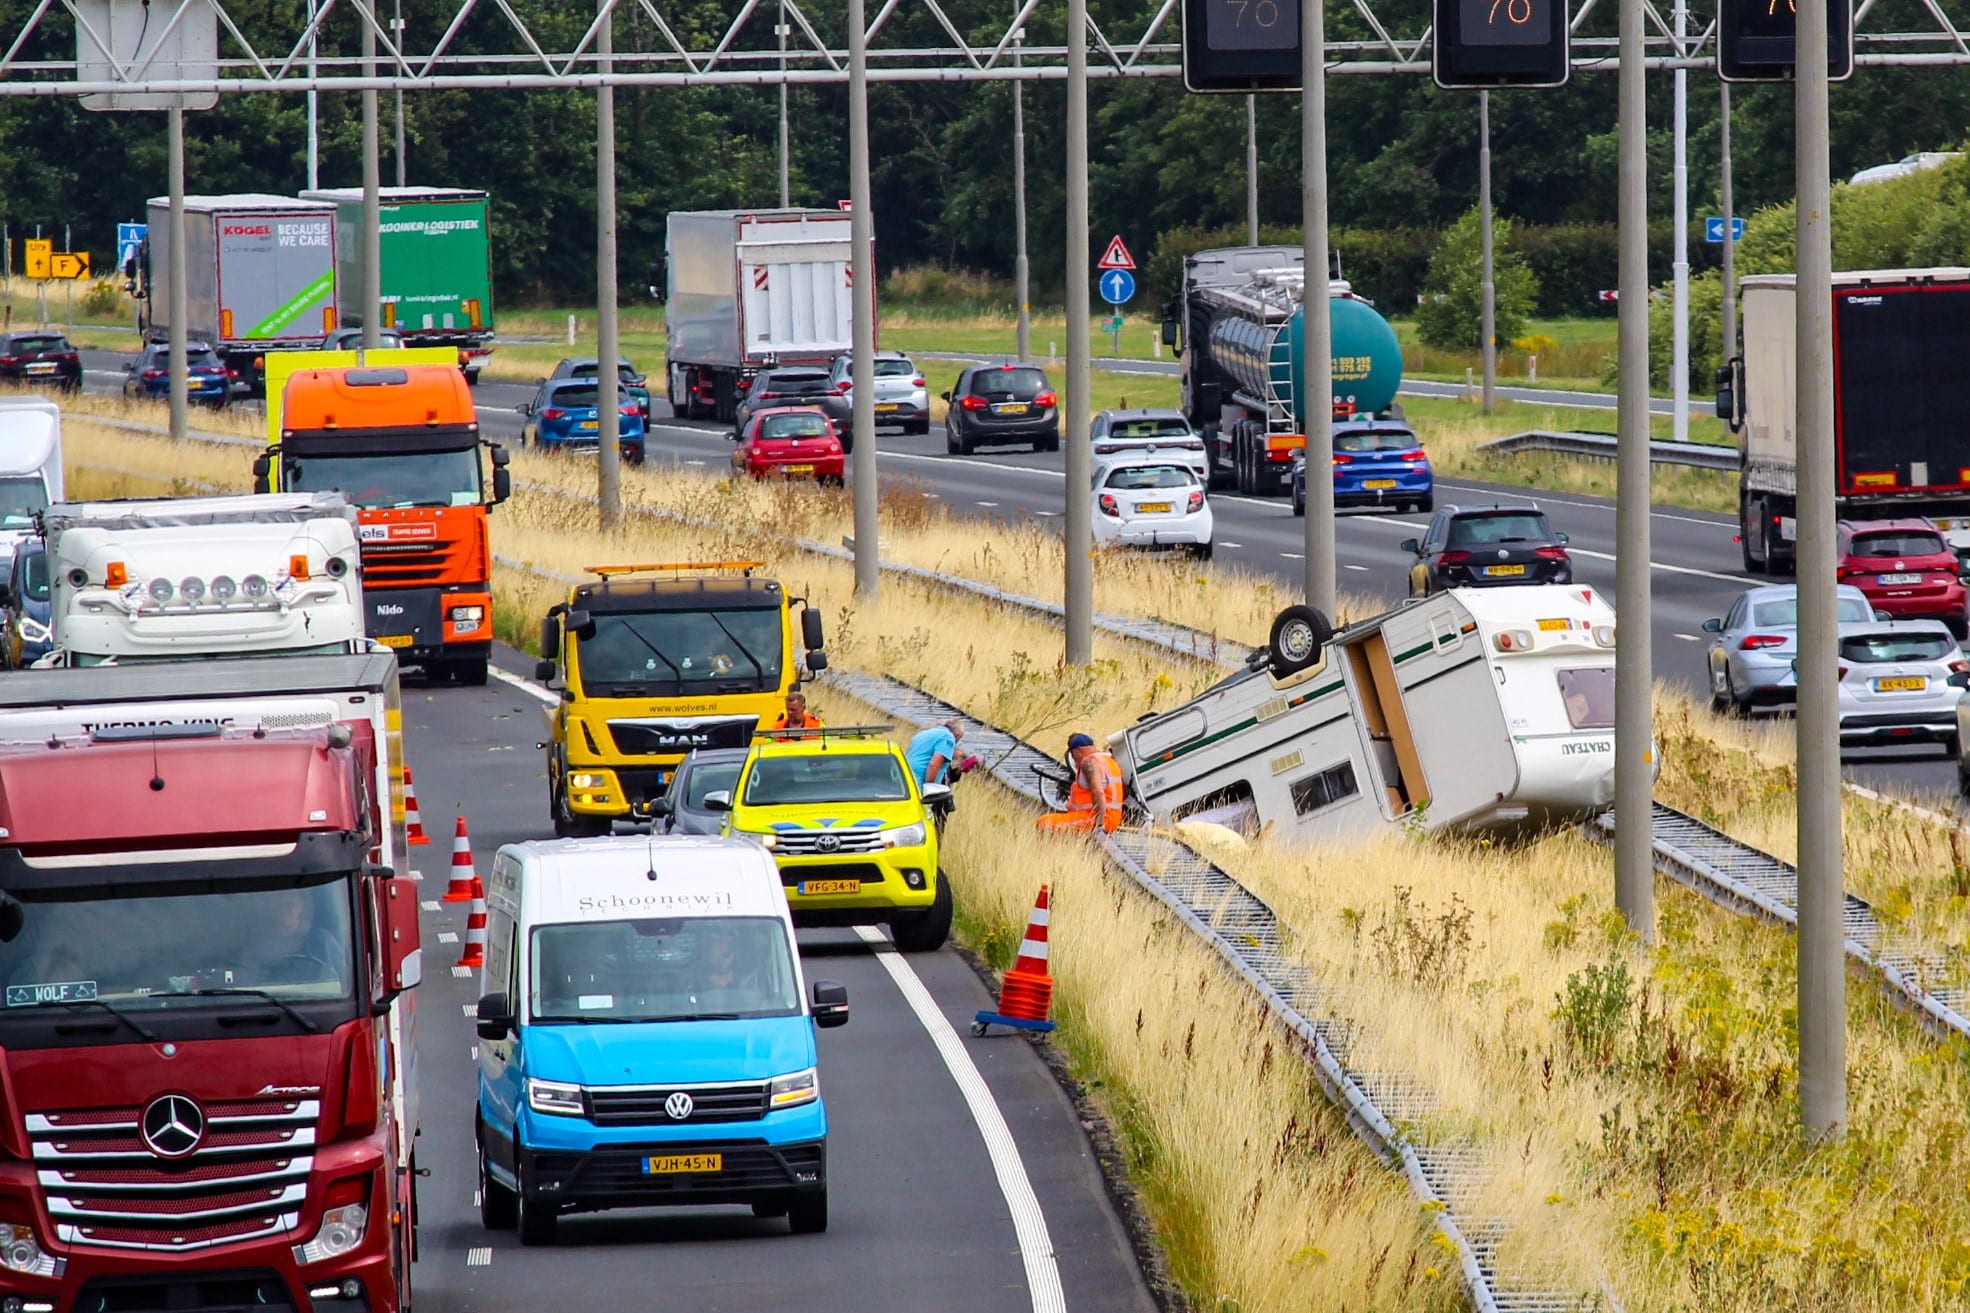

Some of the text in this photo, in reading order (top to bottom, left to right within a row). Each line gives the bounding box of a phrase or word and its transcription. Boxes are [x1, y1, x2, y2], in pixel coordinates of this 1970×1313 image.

[1227, 0, 1278, 28] 70
[277, 223, 329, 235] BECAUSE
[279, 236, 297, 247] WE
[299, 235, 329, 246] CARE
[60, 259, 70, 272] F
[361, 528, 385, 538] els
[377, 604, 404, 616] Nido
[649, 703, 717, 713] www.wolves.nl
[659, 734, 708, 746] MAN
[1561, 741, 1612, 756] CHATEAU
[807, 882, 857, 892] VFG-34-N
[579, 892, 732, 911] Schoonewil
[35, 985, 69, 1001] WOLF
[653, 1157, 716, 1171] VJH-45-N
